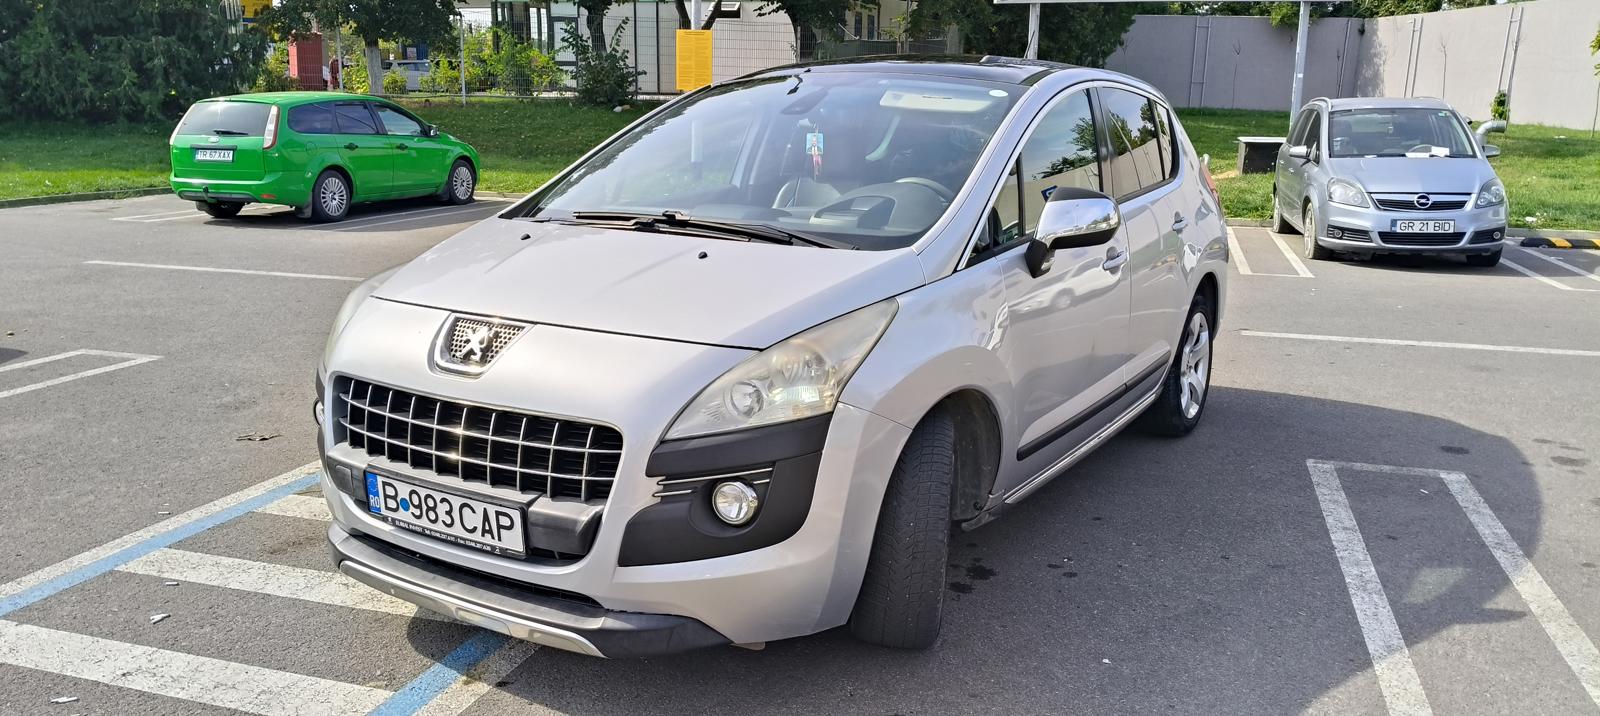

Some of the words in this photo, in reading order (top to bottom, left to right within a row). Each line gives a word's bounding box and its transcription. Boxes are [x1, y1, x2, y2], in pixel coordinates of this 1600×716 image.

[209, 150, 217, 159] 67
[217, 151, 231, 159] XAX
[1399, 221, 1415, 232] GR
[1419, 221, 1429, 232] 21
[1433, 221, 1451, 232] BID
[369, 494, 380, 508] RO
